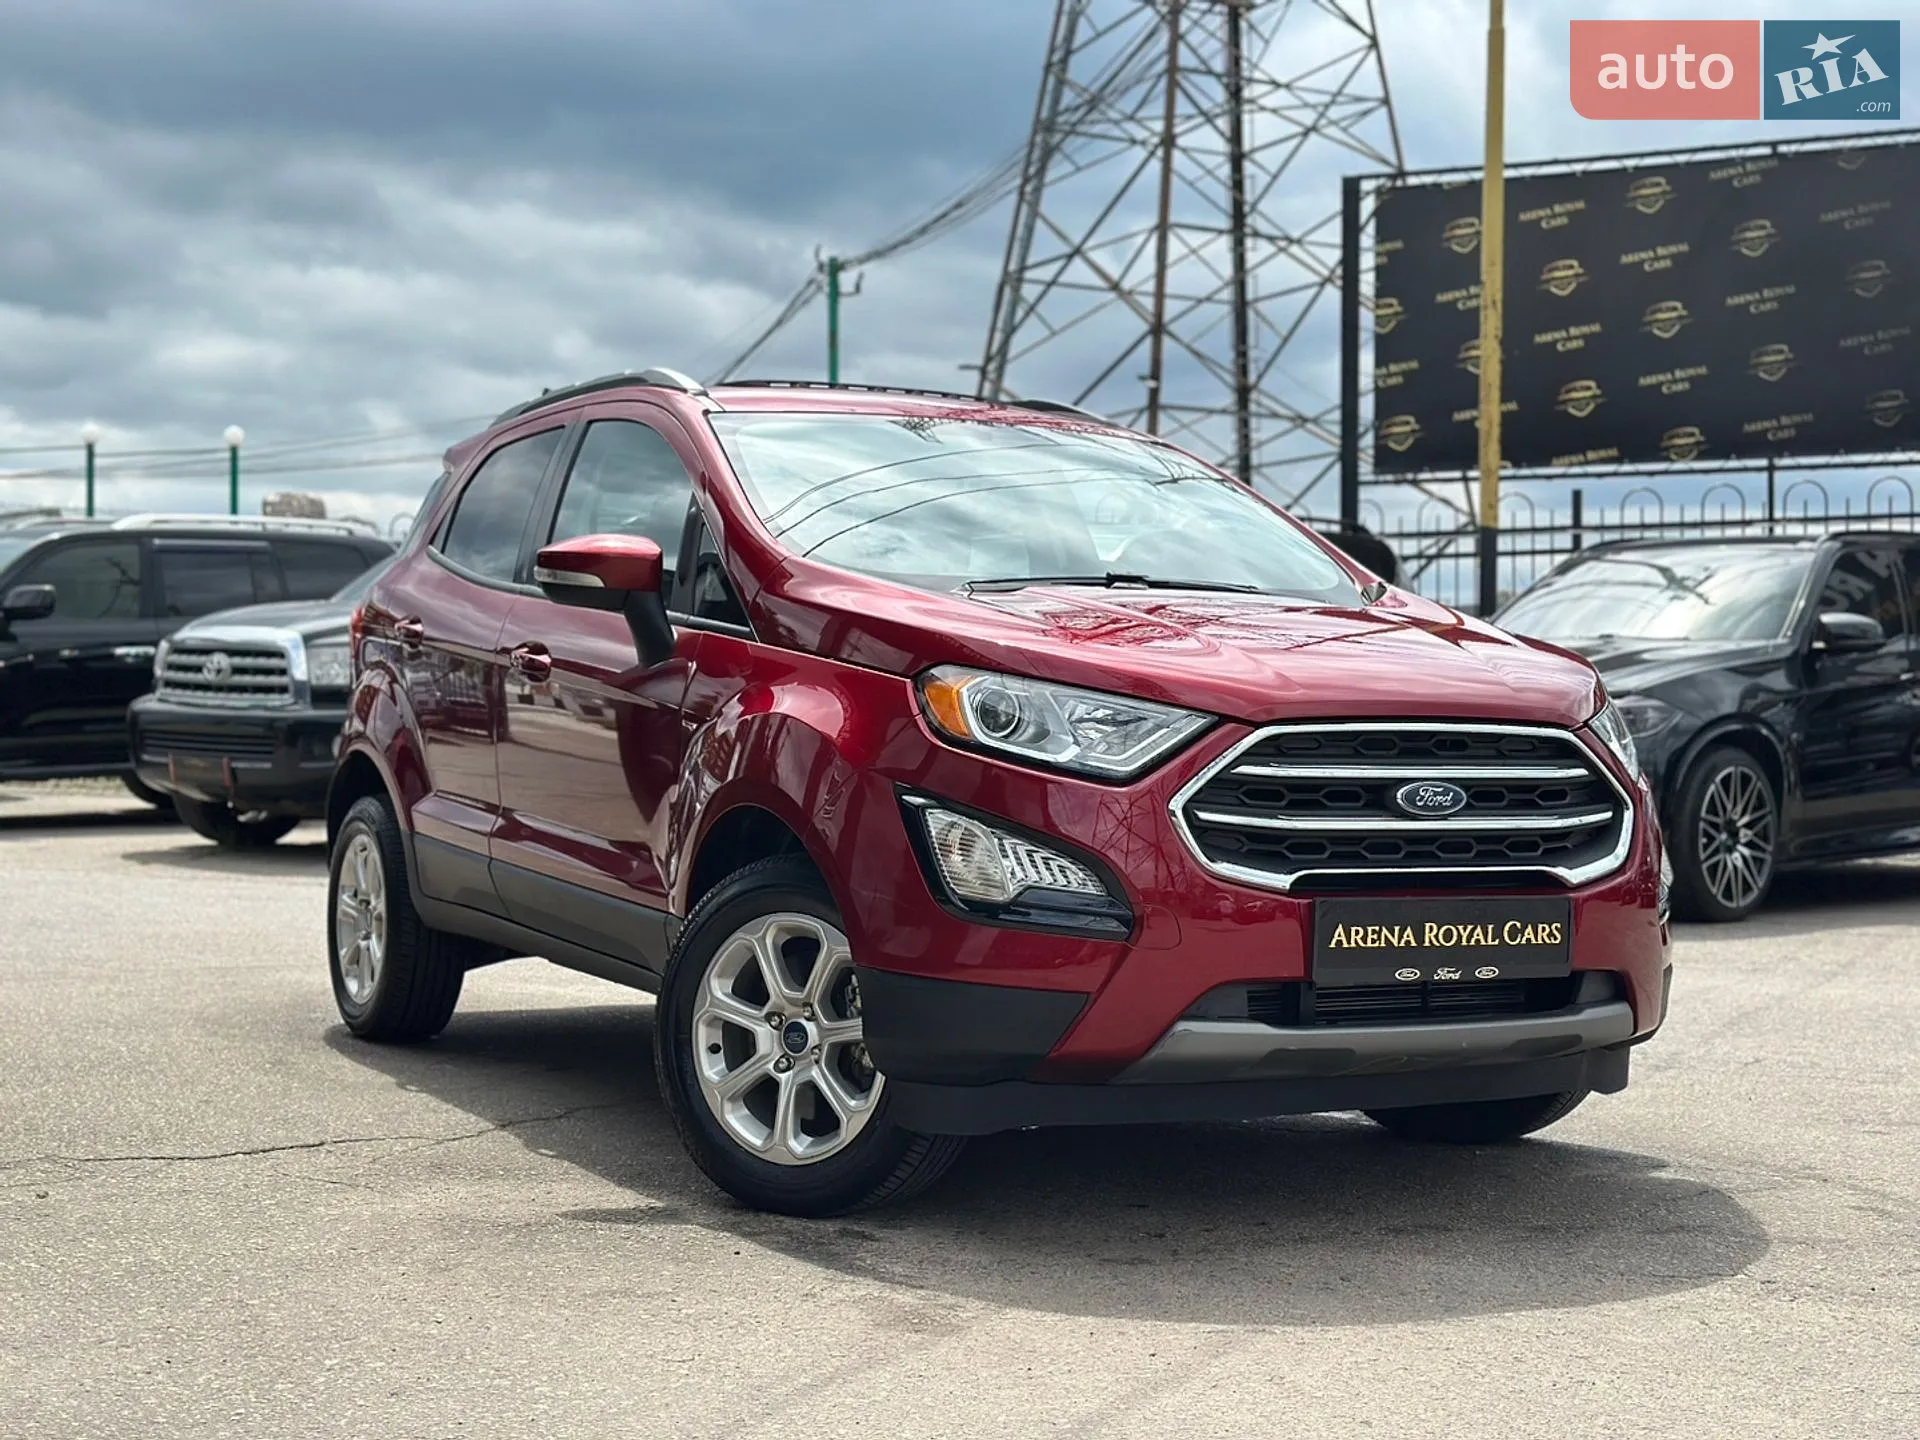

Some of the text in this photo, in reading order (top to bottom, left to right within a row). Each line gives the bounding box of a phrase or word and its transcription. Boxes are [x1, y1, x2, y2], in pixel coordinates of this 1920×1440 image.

[1416, 786, 1454, 806] Ford
[1328, 921, 1562, 949] ARENA ROYAL CARS
[1433, 967, 1462, 980] Ford
